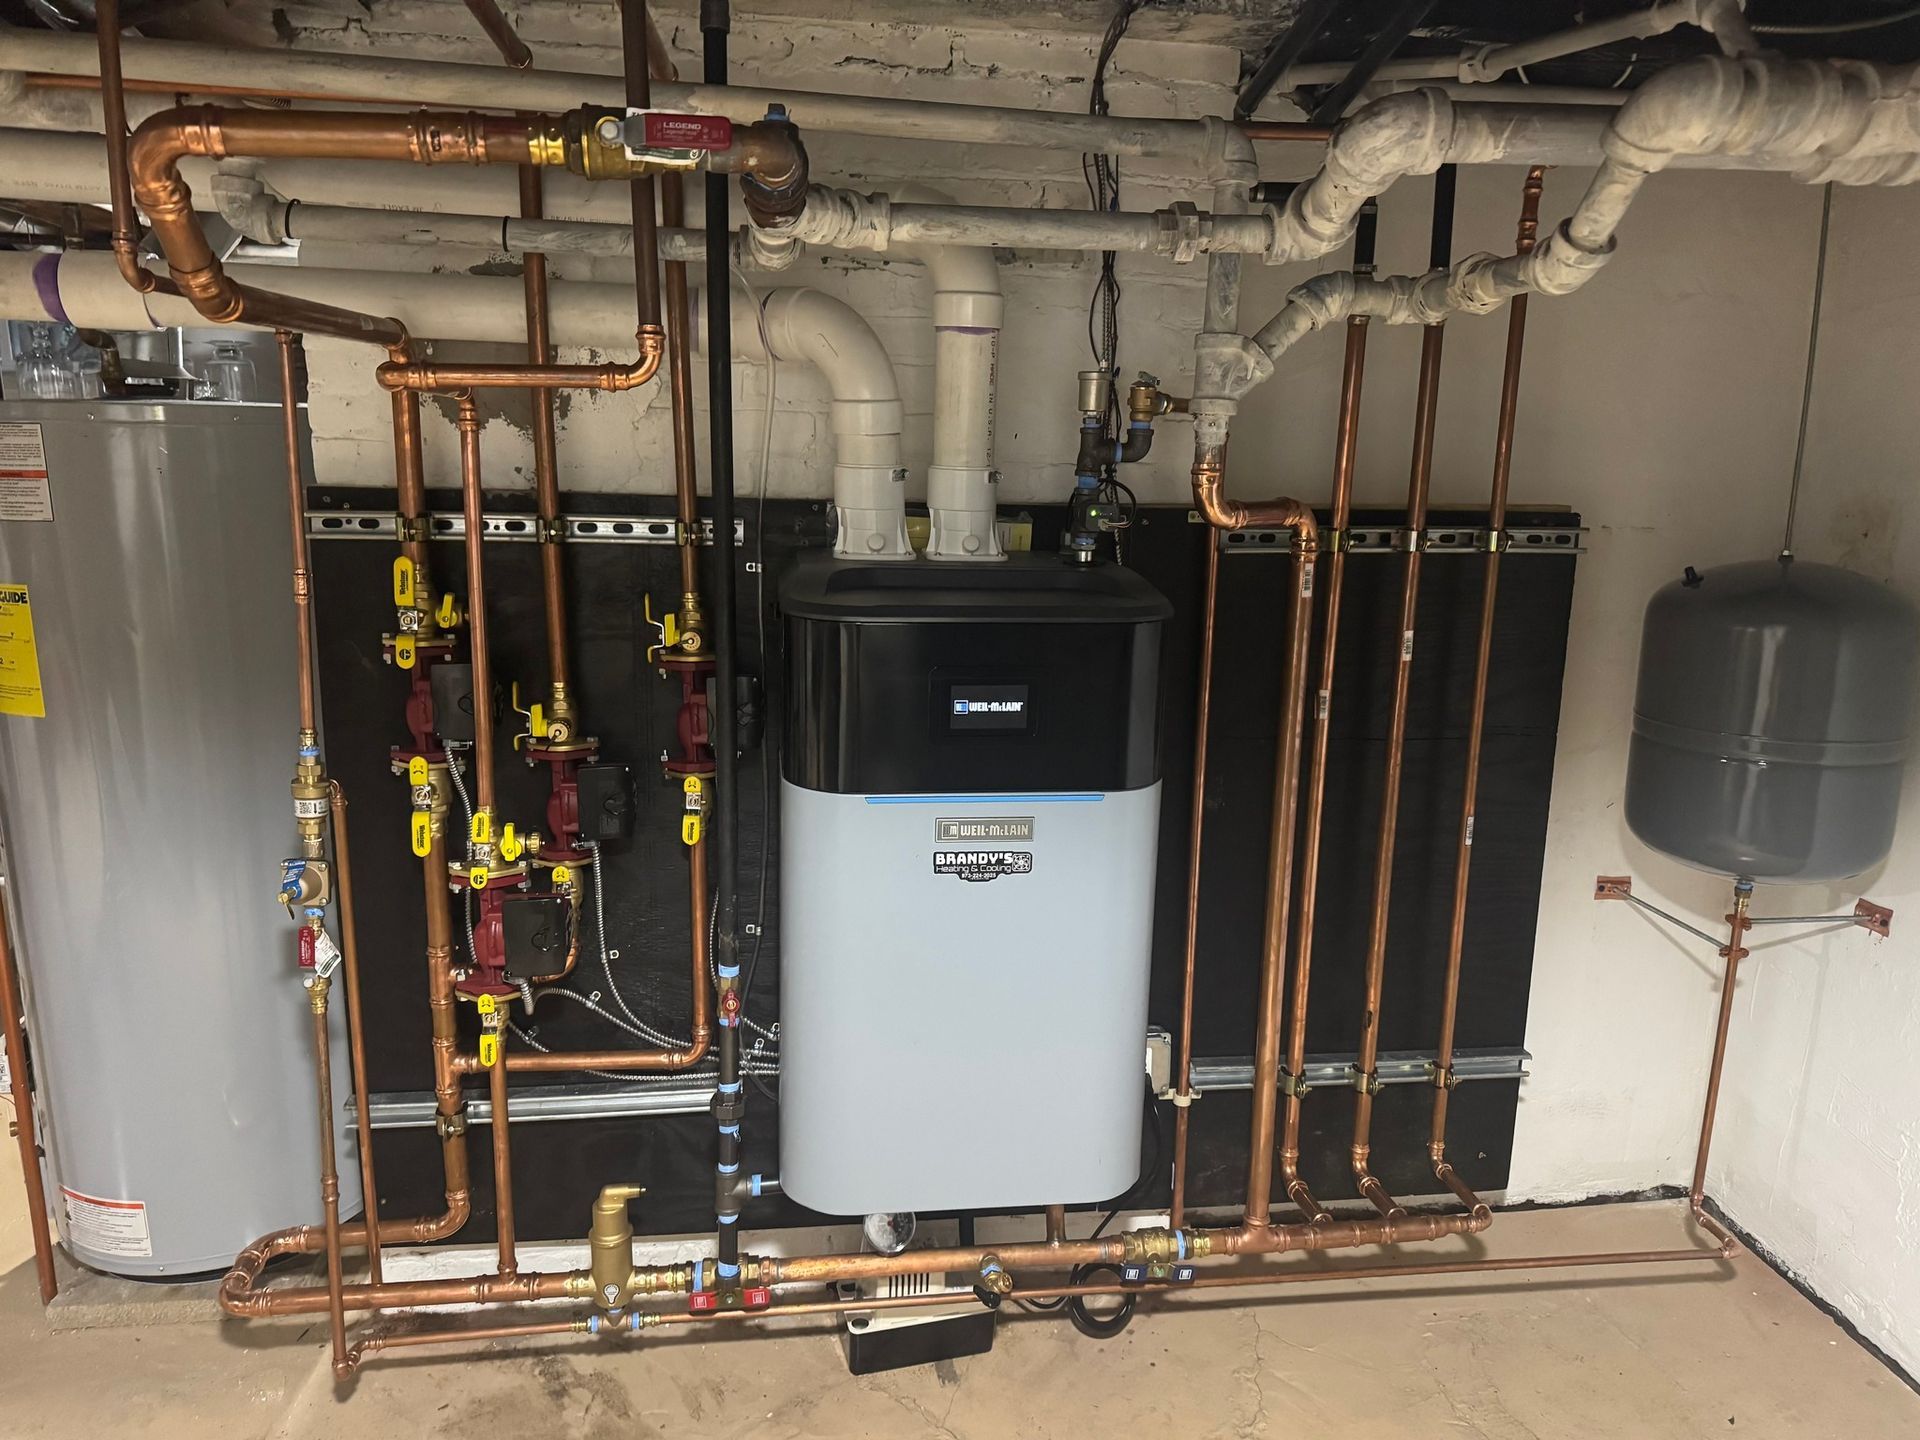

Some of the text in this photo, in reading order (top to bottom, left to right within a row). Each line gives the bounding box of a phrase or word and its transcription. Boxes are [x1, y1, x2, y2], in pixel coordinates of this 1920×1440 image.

[935, 853, 1013, 865] BRANDY'S
[936, 865, 969, 873] Heating
[980, 865, 1012, 873] Cooling
